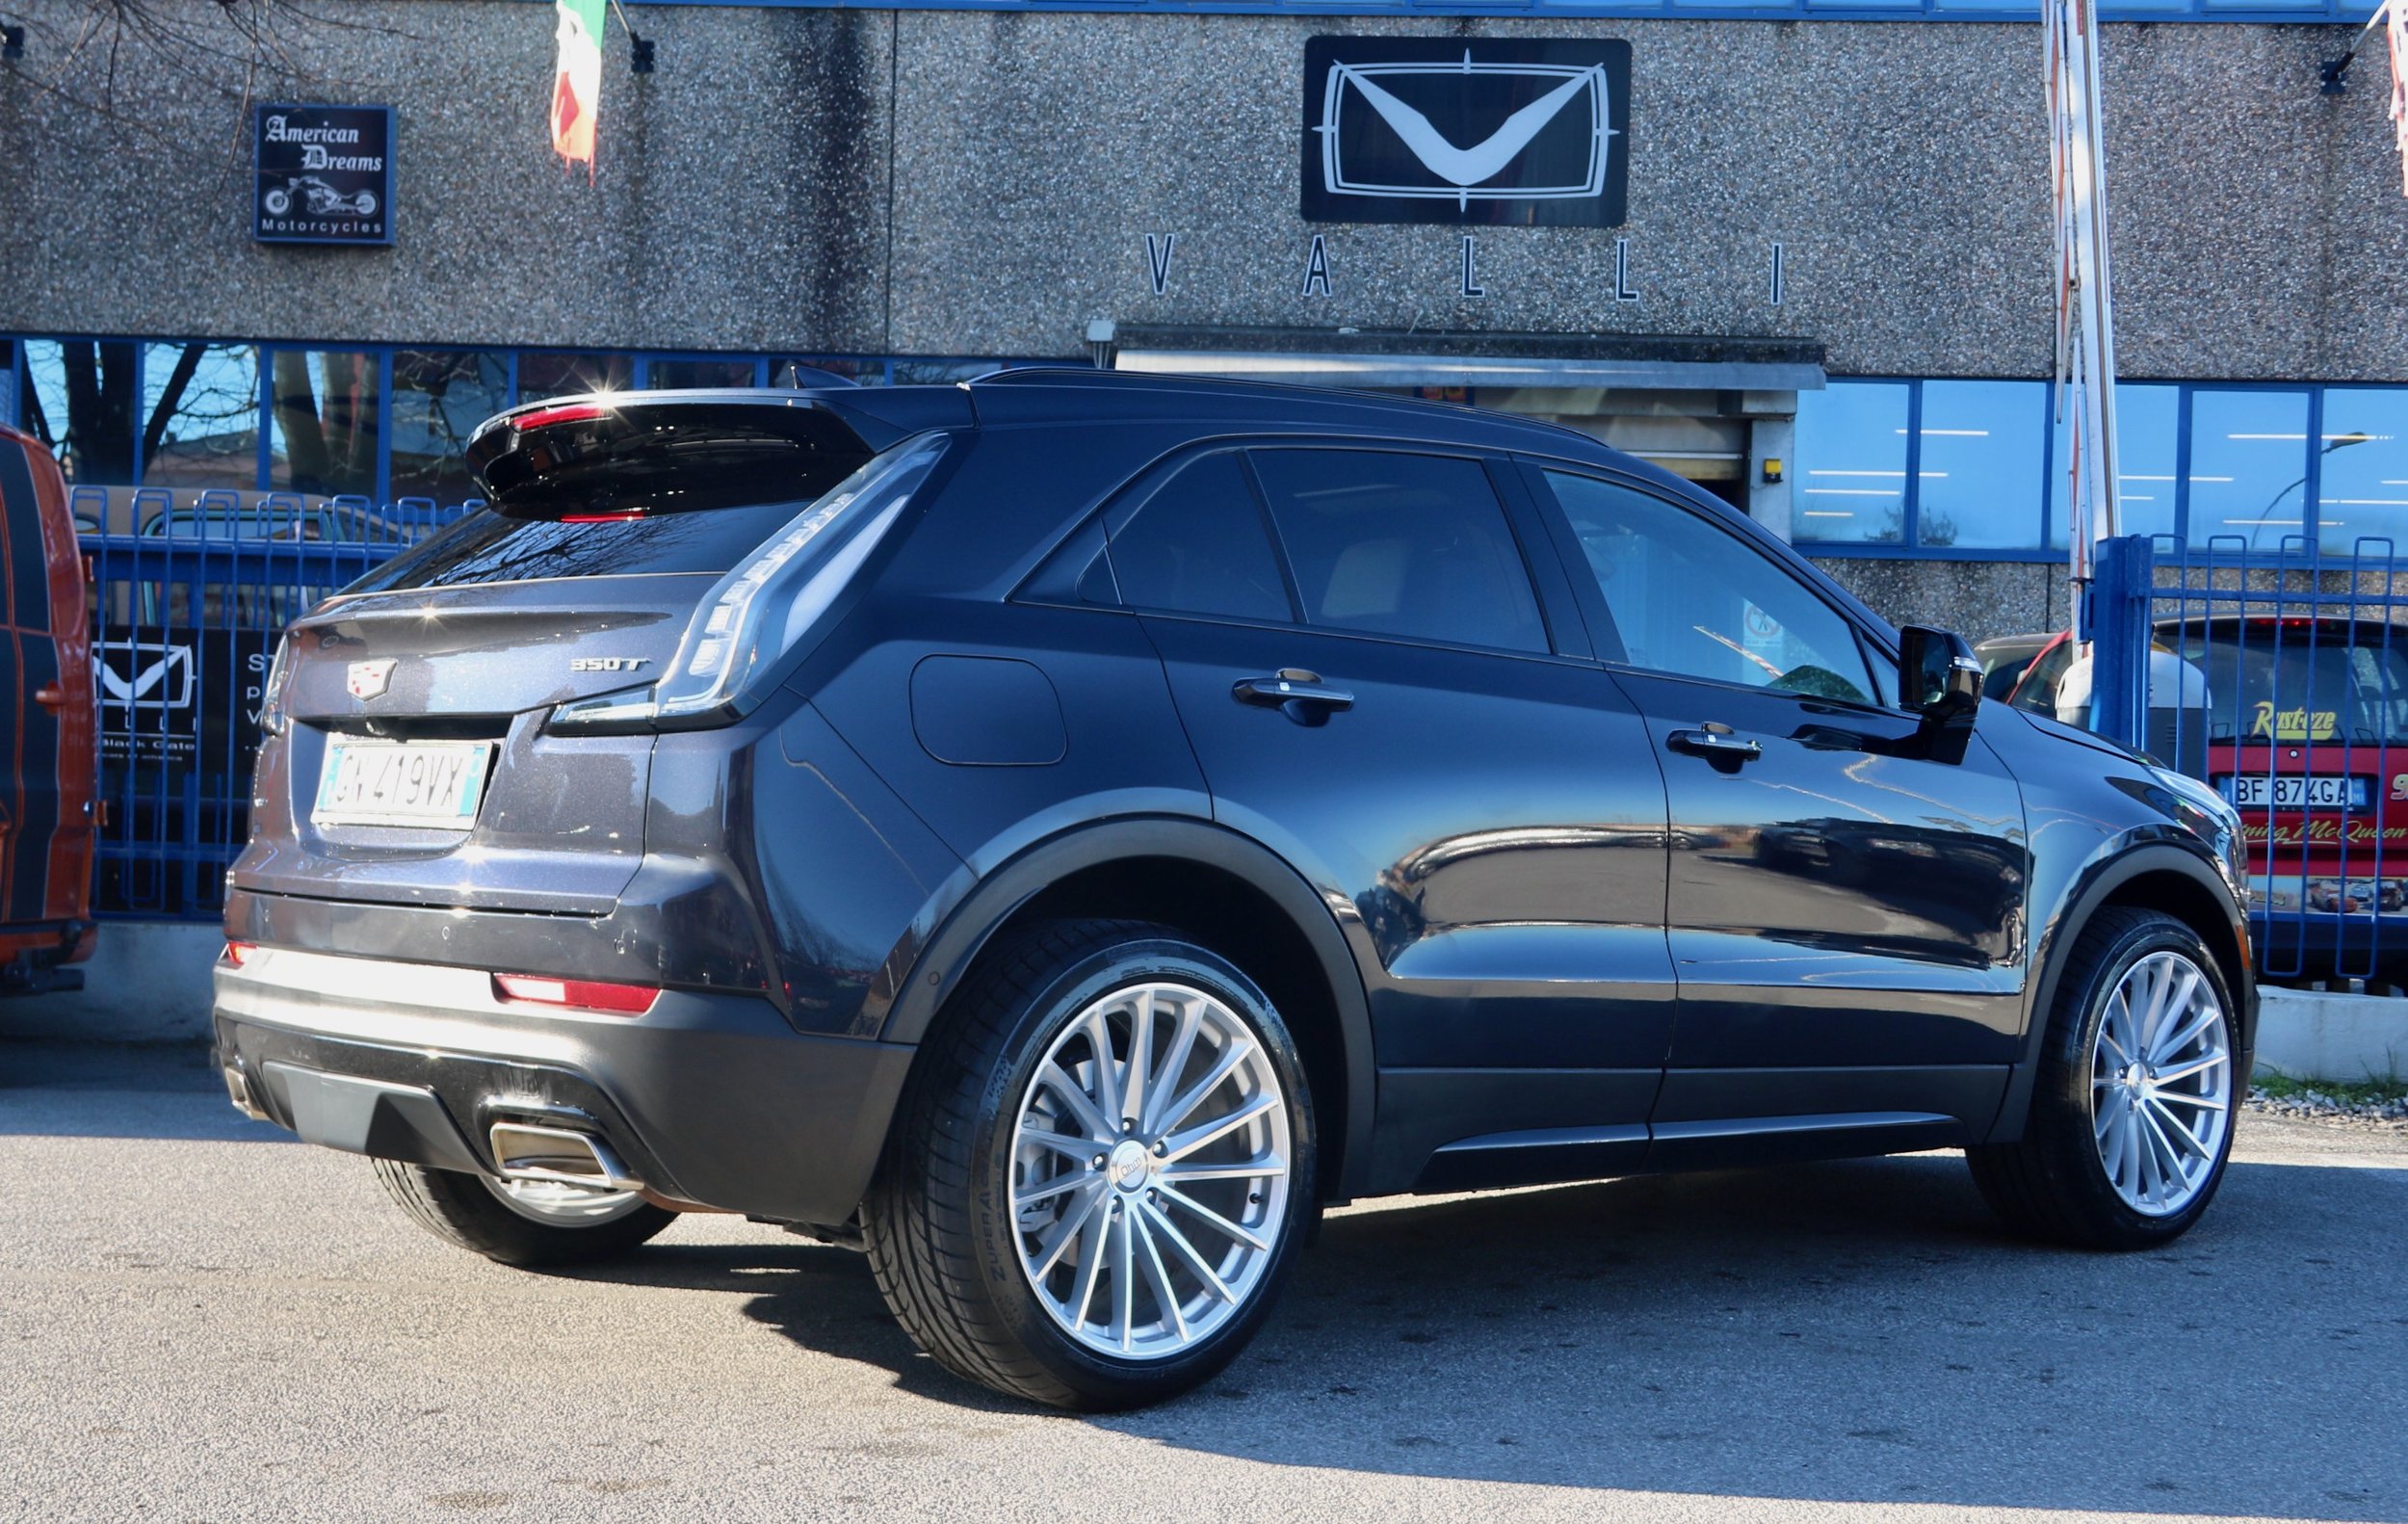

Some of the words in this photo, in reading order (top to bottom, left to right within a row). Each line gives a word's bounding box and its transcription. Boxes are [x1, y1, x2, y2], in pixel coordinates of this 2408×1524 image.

[265, 115, 359, 144] American
[301, 144, 382, 171] Dreams
[262, 219, 381, 234] Motorcycles
[1144, 233, 1783, 305] VALLI
[570, 657, 652, 672] 350T
[2237, 779, 2264, 802] BF
[2275, 779, 2349, 803] 874GA
